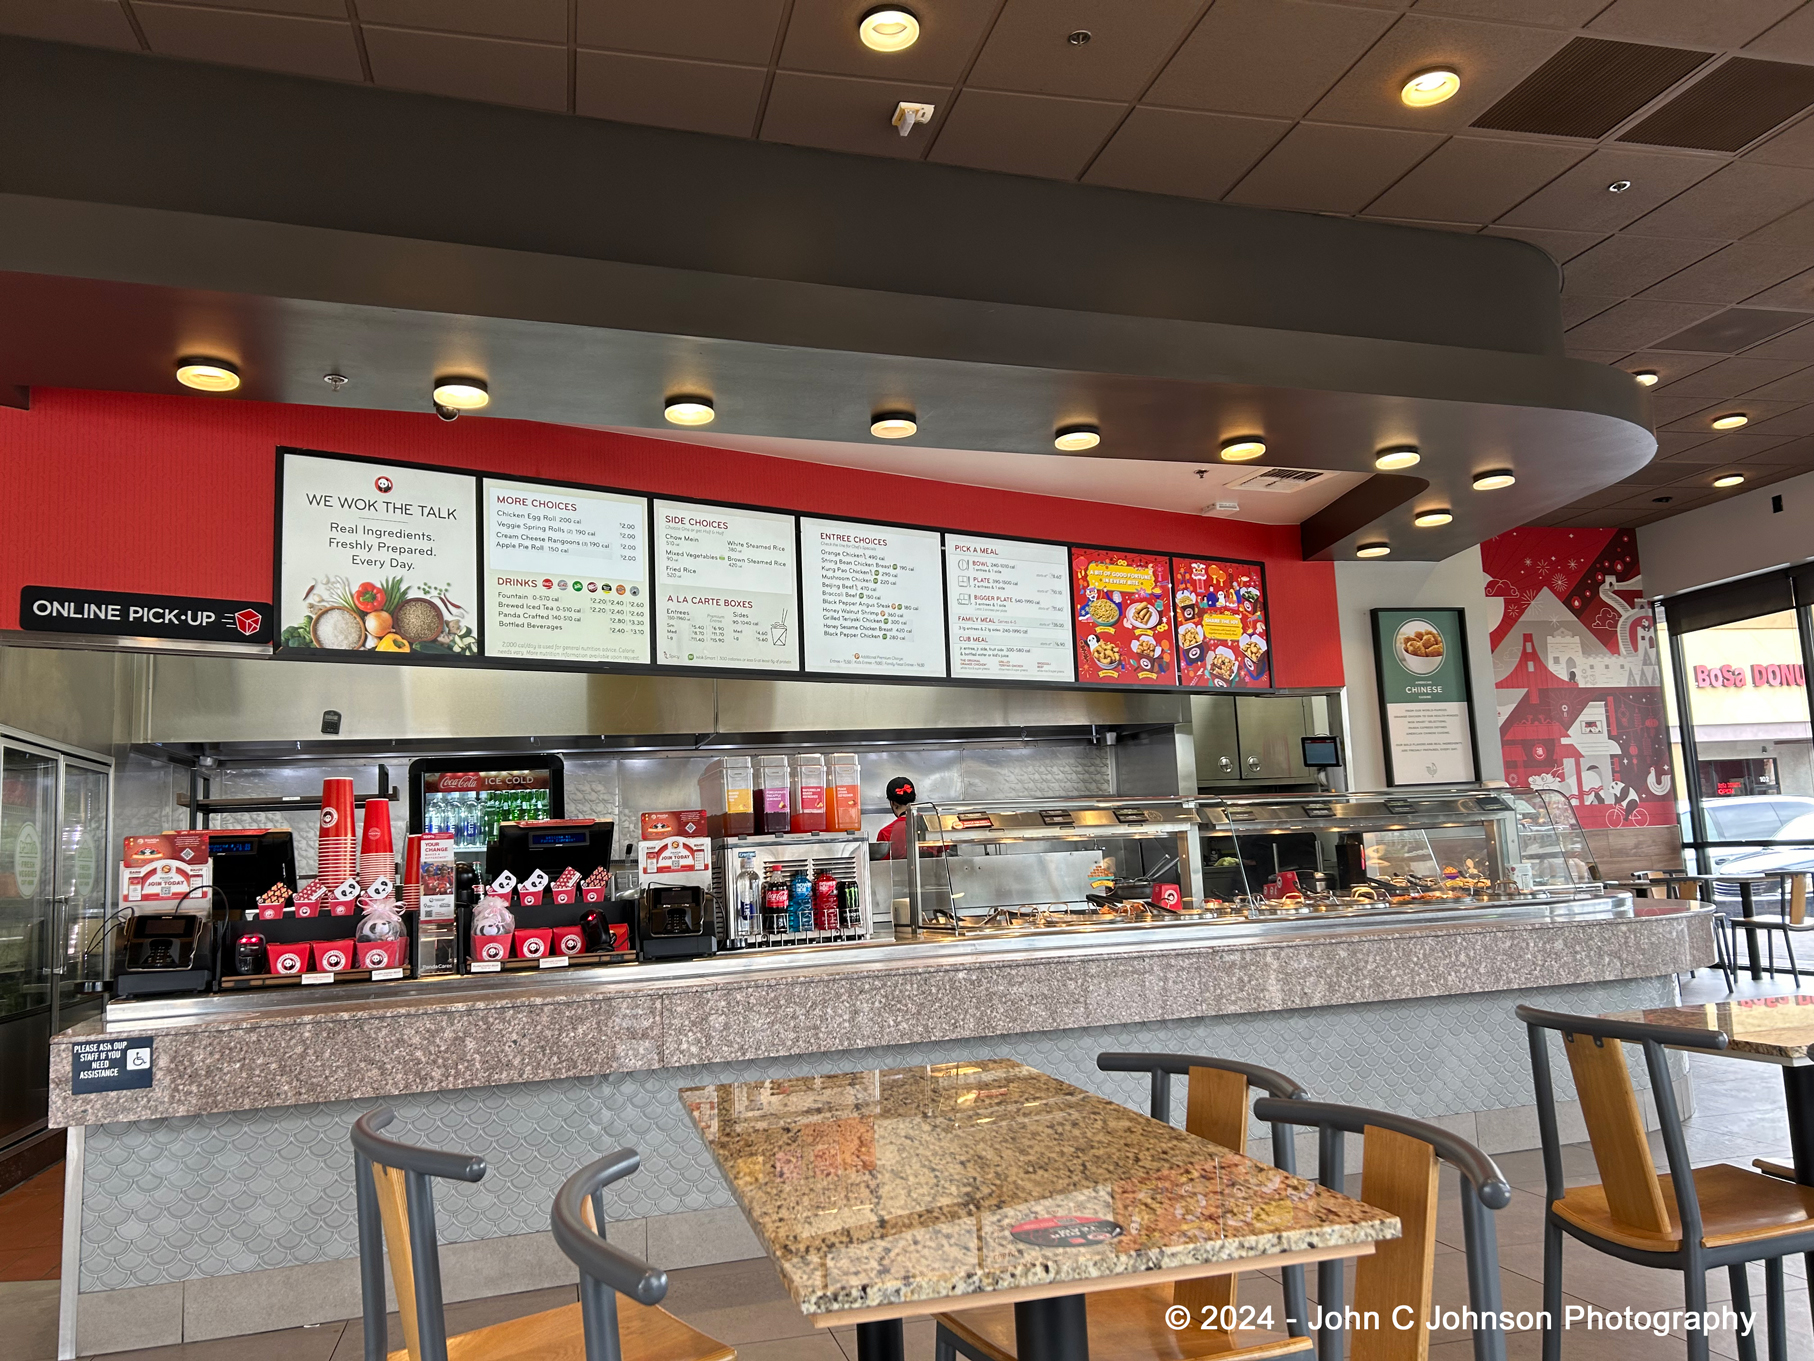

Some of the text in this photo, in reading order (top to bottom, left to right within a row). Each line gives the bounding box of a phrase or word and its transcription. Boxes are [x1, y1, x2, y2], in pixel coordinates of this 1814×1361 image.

[306, 493, 457, 520] WE WOK THE TALK
[497, 496, 577, 512] MORE CHOICES
[497, 510, 525, 519] Chicken
[528, 513, 541, 522] Egg
[665, 515, 729, 530] SIDE CHOICES
[330, 522, 435, 542] Real Ingredients.
[497, 521, 521, 530] Veggie
[523, 524, 546, 534] Spring
[549, 526, 565, 534] Rolls
[620, 532, 636, 540] $2.00
[496, 532, 519, 540] Cream
[521, 534, 546, 542] Cheese
[548, 537, 581, 547] Rangoons
[620, 543, 636, 551] $2.00
[727, 540, 744, 548] White
[746, 542, 771, 550] Steamed
[821, 533, 888, 546] ENTREE CHOICES
[329, 538, 437, 557] Freshly Prepared.
[821, 549, 841, 557] Orange
[980, 548, 999, 556] MEAL
[620, 554, 636, 562] $2.00
[685, 552, 718, 560] Vegetables
[352, 555, 415, 571] Every Day.
[498, 577, 538, 588] DRINKS
[498, 592, 528, 600] Fountain
[667, 595, 753, 609] A LA CARTE BOXES
[33, 600, 121, 621] ONLINE
[498, 611, 520, 619] Panda
[667, 608, 690, 616] Entrees
[527, 623, 563, 631] Beverages
[840, 632, 859, 640] Pepper
[1406, 686, 1443, 694] CHINESE
[440, 776, 479, 789] Coca-Cola
[74, 1044, 98, 1053] PLEASE
[80, 1051, 121, 1062] STAFF IF YOU
[92, 1061, 109, 1069] NEED
[79, 1068, 119, 1079] ASSISTANCE
